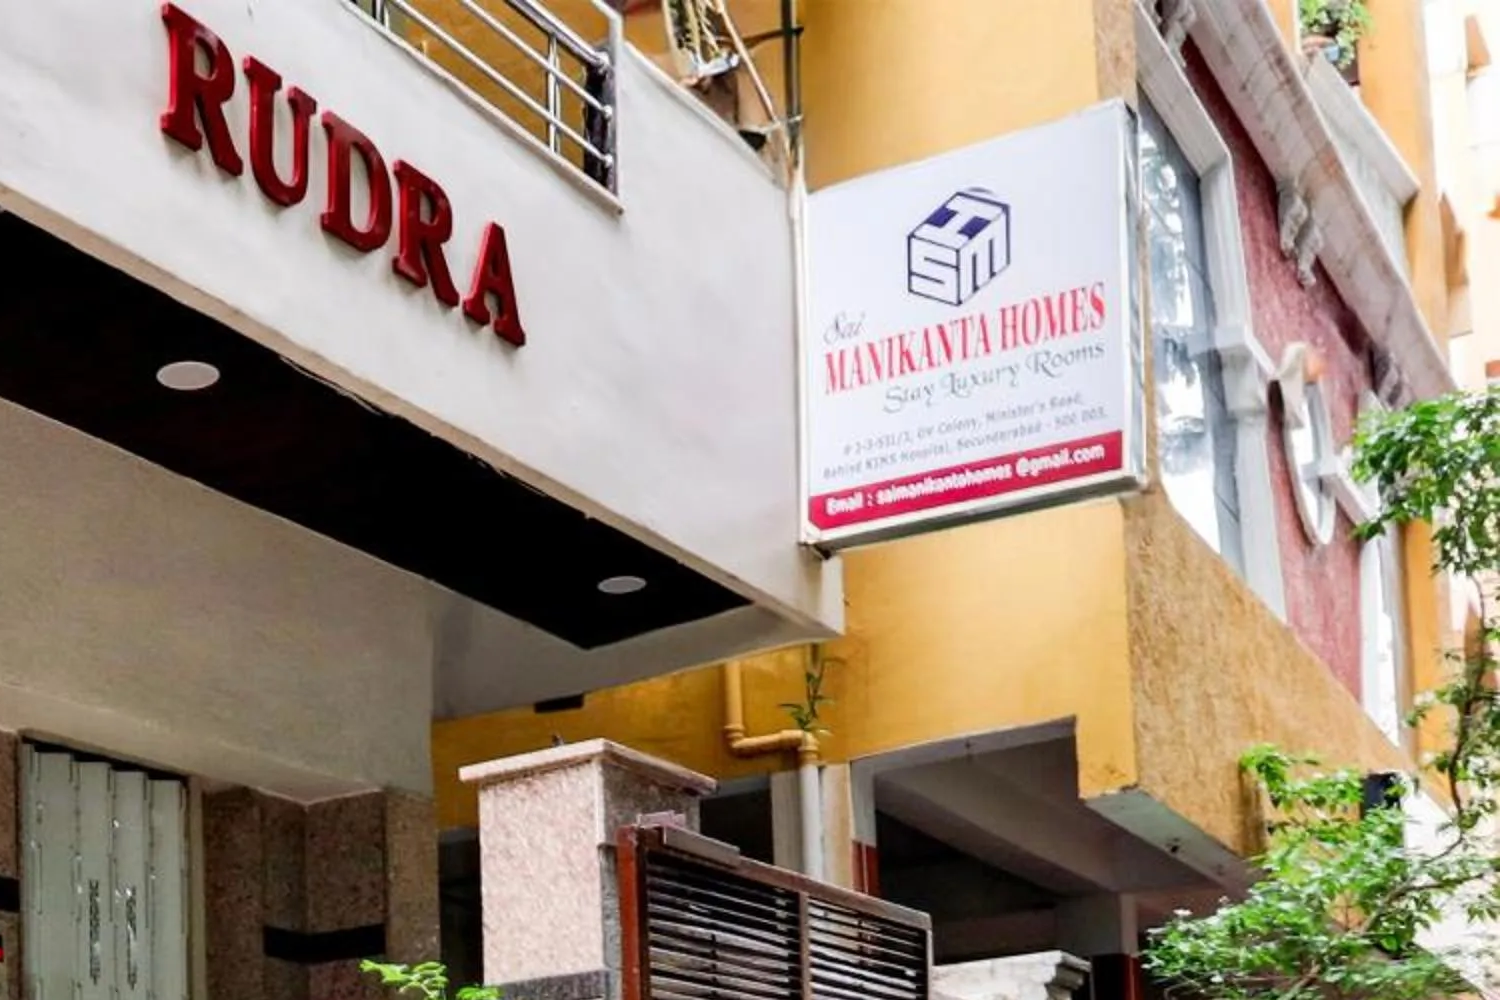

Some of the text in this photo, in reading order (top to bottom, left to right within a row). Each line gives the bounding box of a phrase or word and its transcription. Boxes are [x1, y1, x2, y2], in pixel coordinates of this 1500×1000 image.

[161, 2, 526, 347] RUDRA
[823, 310, 867, 345] Sai
[824, 280, 1106, 396] MANIKANTA HOMES
[882, 341, 1106, 415] Stay Luxury Rooms
[825, 490, 864, 516] Email
[876, 462, 1013, 506] saimanikantahomes
[1015, 444, 1106, 479] @gmail.com
